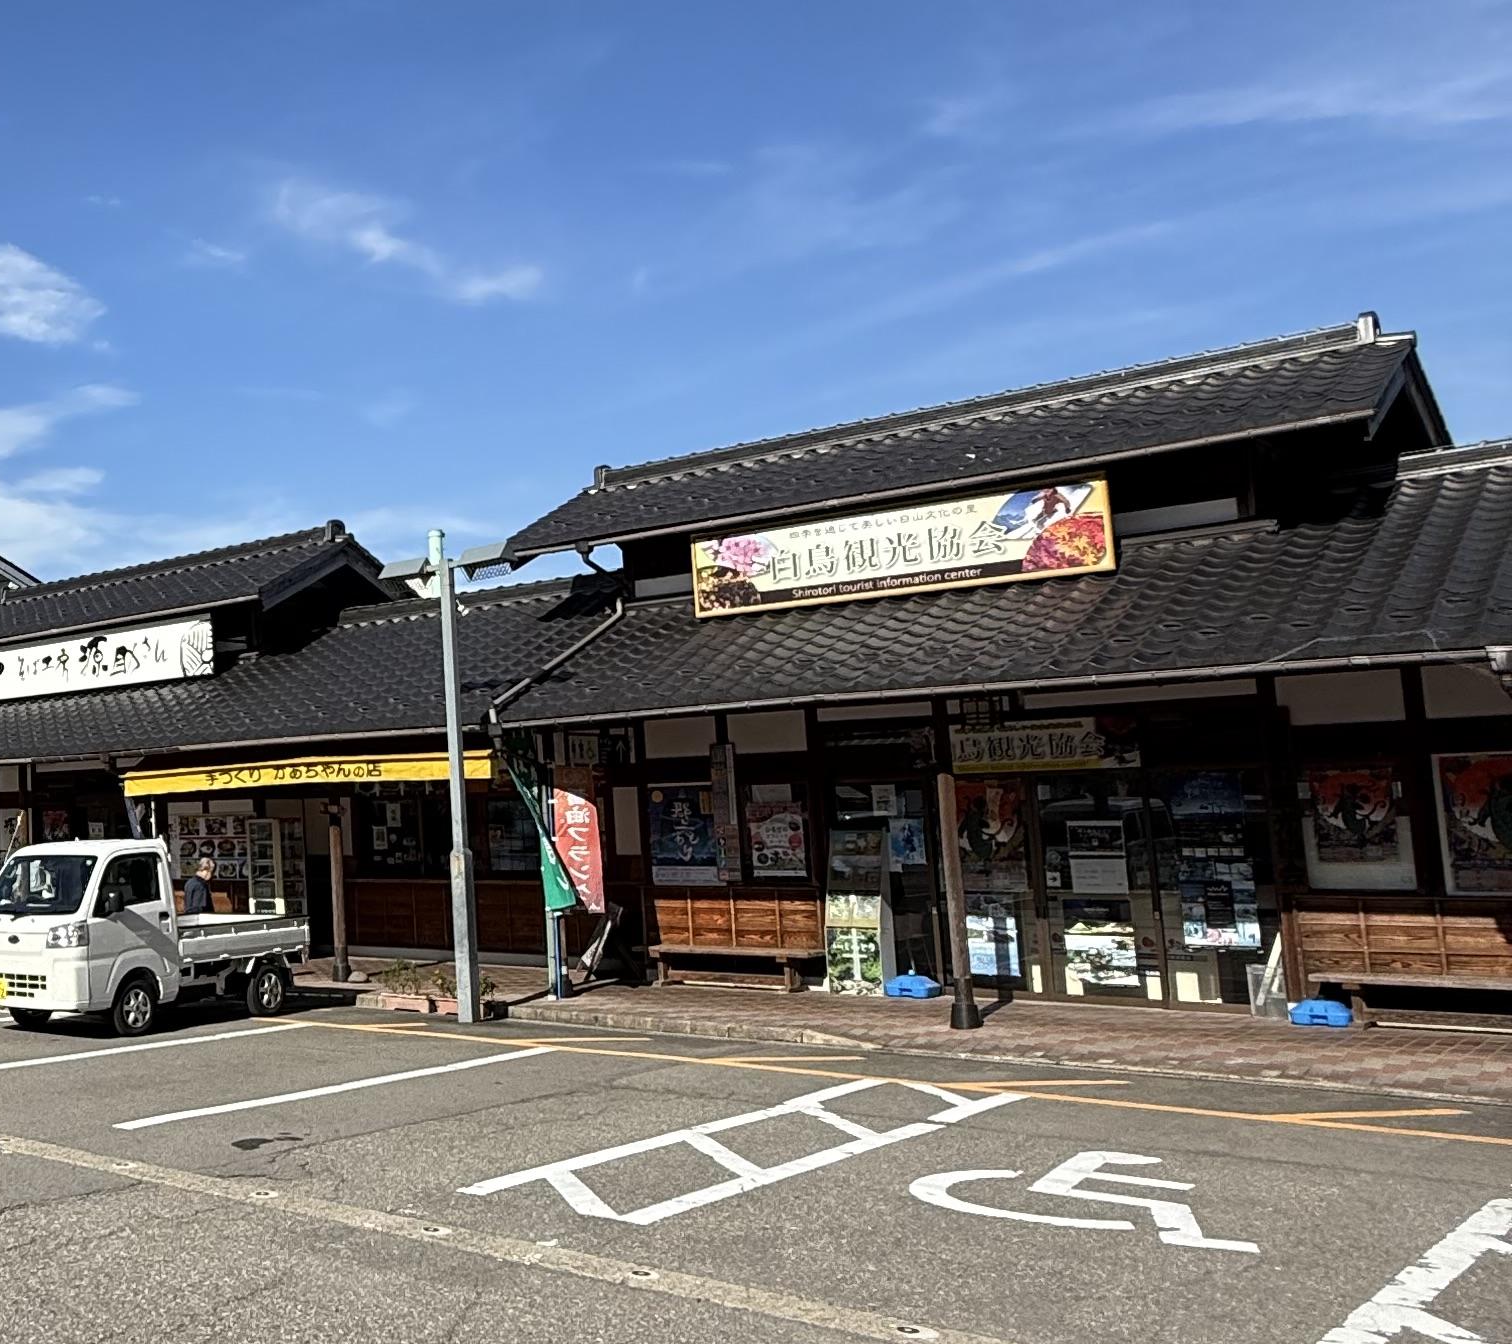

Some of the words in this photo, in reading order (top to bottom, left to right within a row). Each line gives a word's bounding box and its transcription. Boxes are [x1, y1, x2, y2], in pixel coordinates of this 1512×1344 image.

[788, 503, 978, 540] 四季を通じて美しい白山文化の里
[772, 520, 1005, 581] 白鳥観光協会
[791, 585, 837, 599] Shirotori
[839, 579, 874, 594] tourist
[876, 572, 942, 589] information
[943, 567, 982, 581] center
[953, 731, 1107, 763] 鳥観光協会
[204, 766, 262, 786] 手づくり
